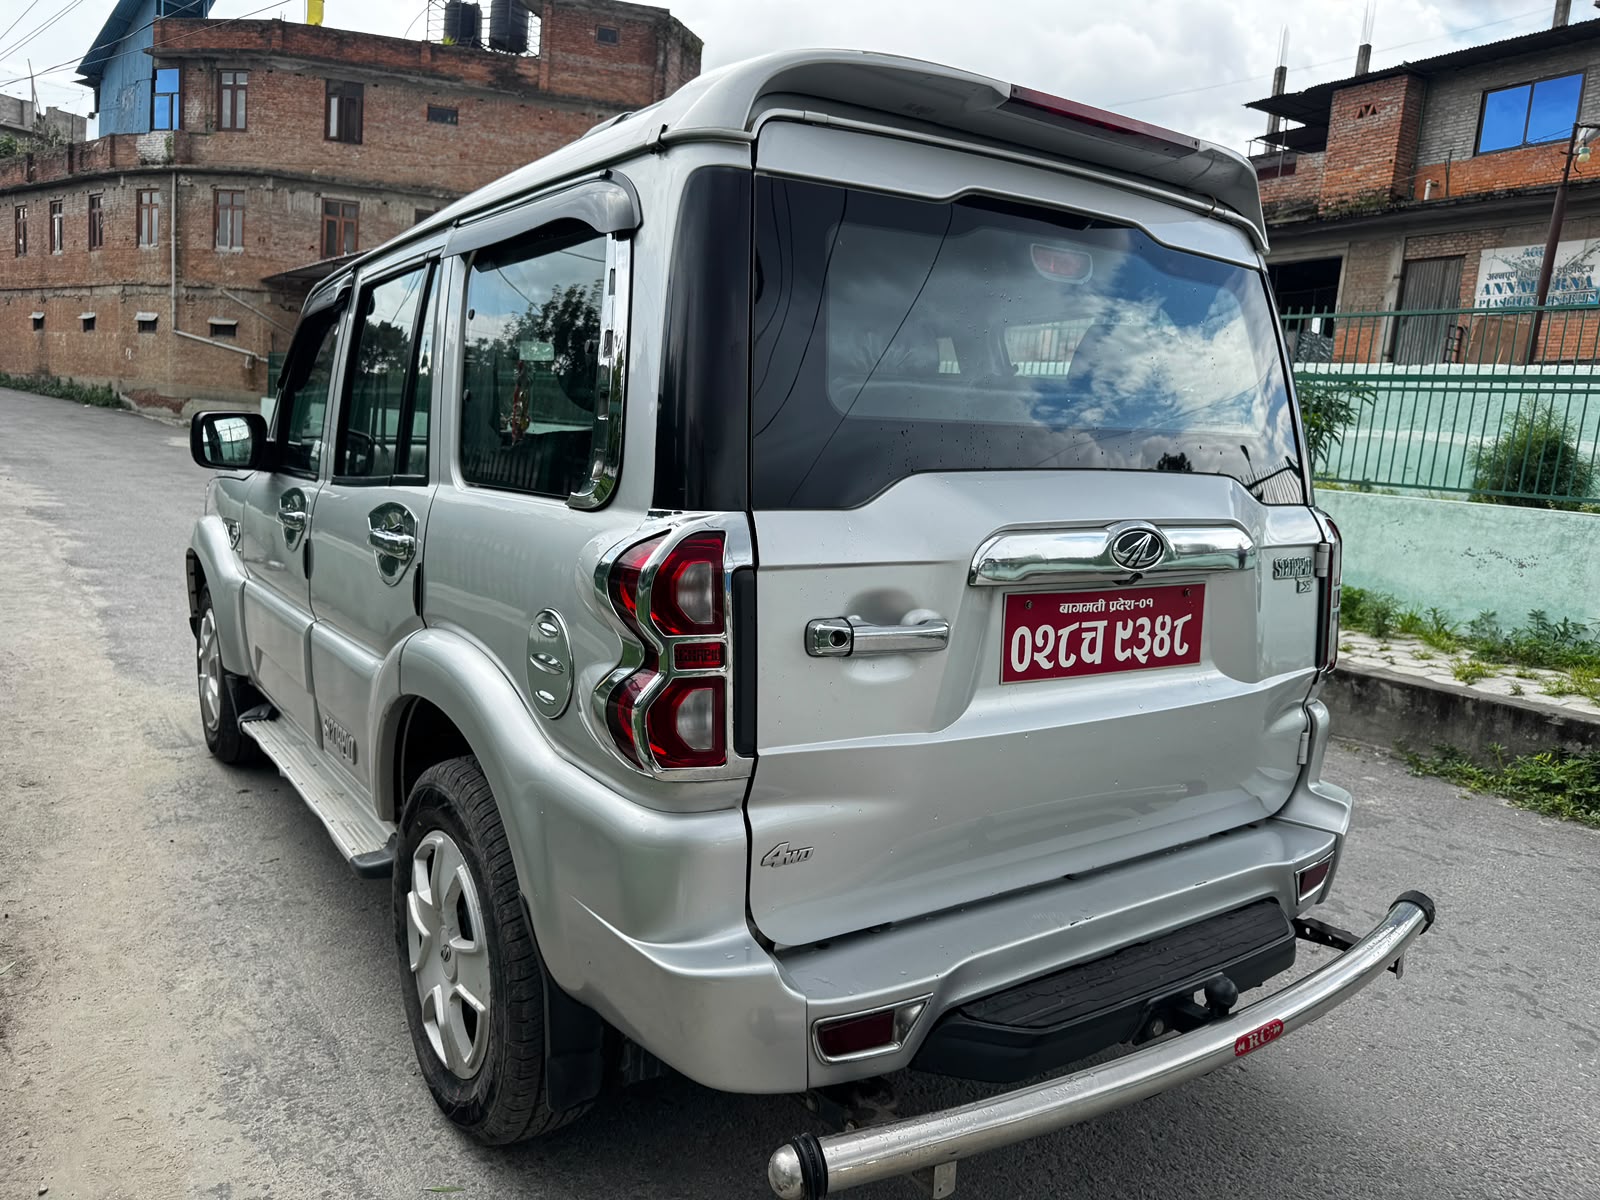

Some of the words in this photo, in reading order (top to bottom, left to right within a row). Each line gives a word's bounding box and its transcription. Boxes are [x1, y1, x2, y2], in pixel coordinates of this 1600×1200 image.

[1059, 598, 1106, 614] बागमती
[1114, 613, 1193, 665] ५३४८
[760, 841, 814, 868] 4WD
